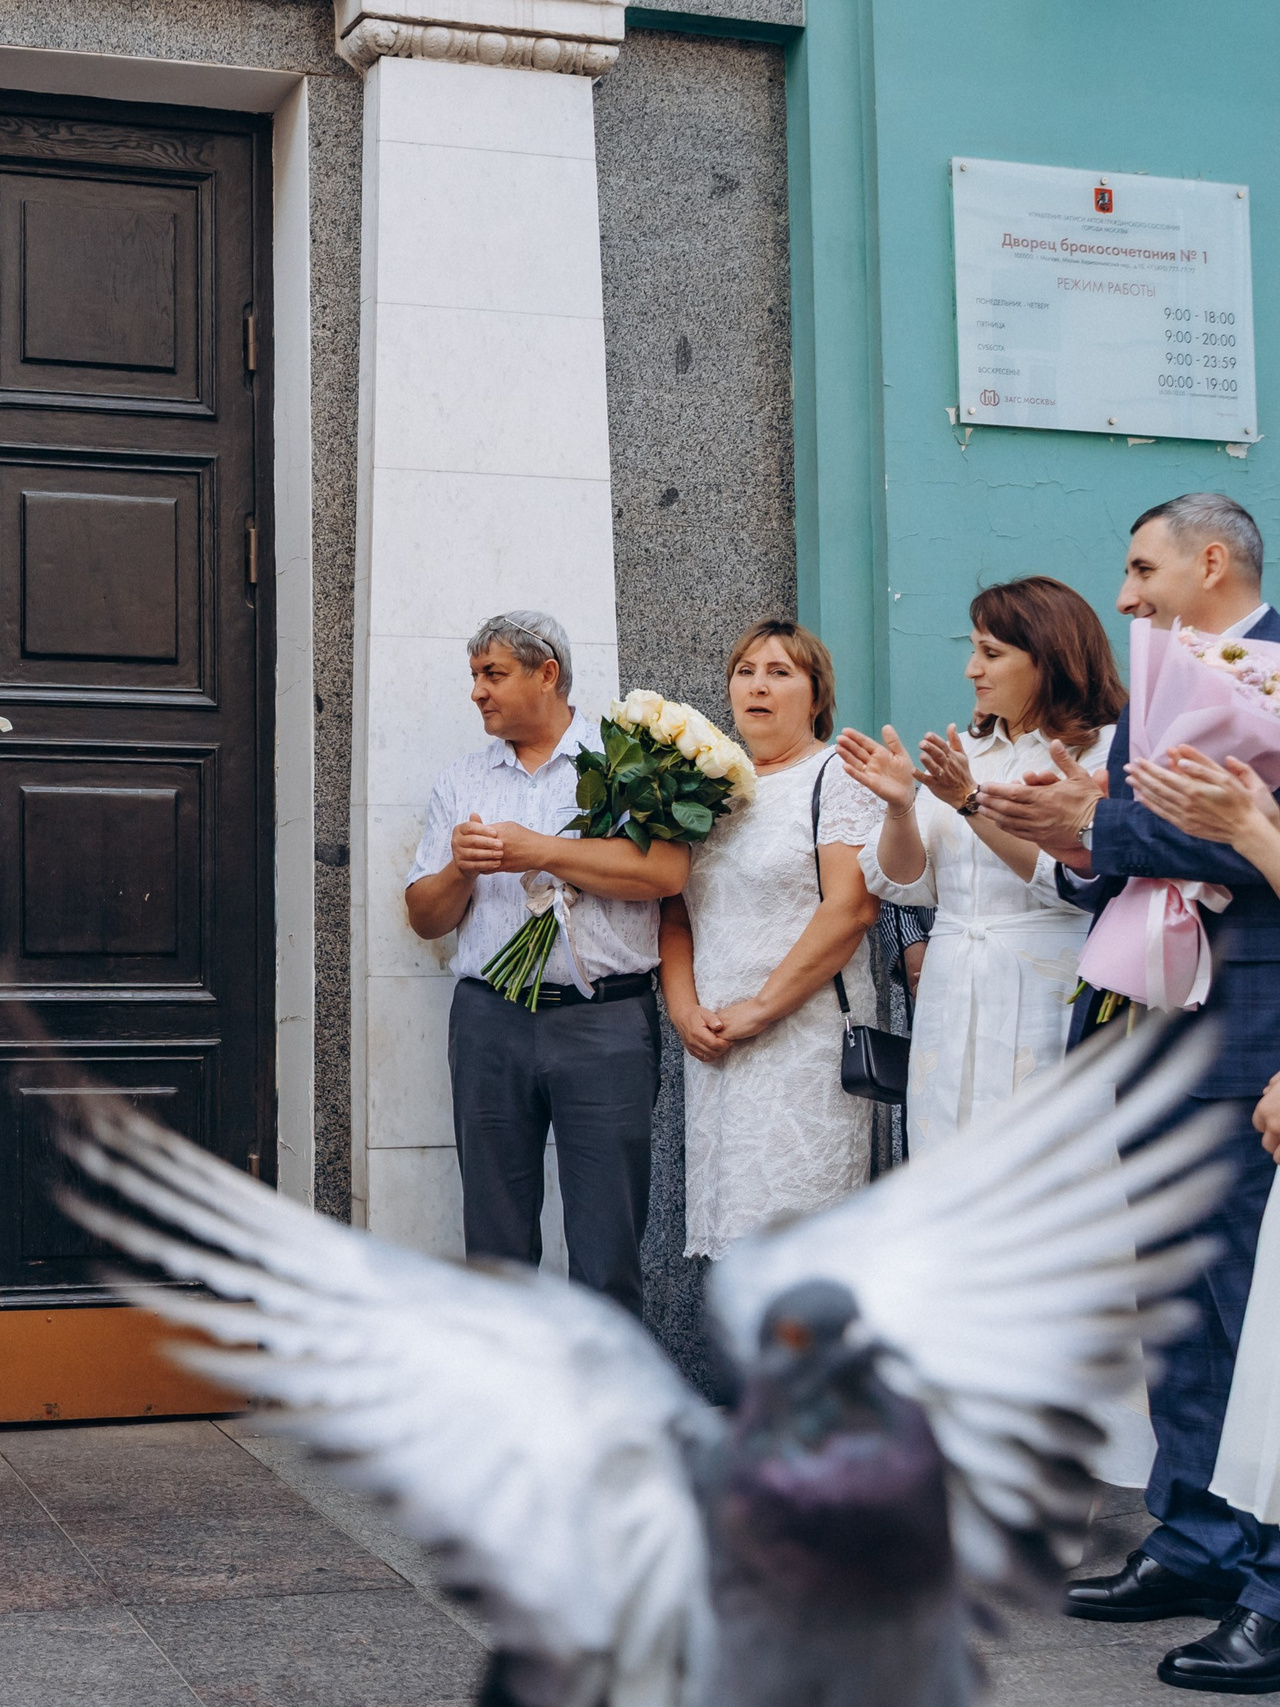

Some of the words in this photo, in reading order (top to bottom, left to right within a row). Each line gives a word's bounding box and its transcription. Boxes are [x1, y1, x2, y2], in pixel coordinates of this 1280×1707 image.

[1002, 233, 1056, 252] Дворец
[1060, 238, 1176, 261] бракосочетания
[1180, 248, 1196, 262] №
[1202, 251, 1207, 264] 1
[1057, 278, 1104, 292] РЕЖИМ
[1108, 282, 1156, 298] РАБОТЫ
[976, 298, 1022, 308] ПОНЕДЕЛЬНИК
[1027, 302, 1050, 310] ЧЕТВЕРГ
[1164, 307, 1191, 322] 9:00
[1204, 310, 1236, 325] 18:00
[976, 320, 1006, 330] ПЯТНИЦА
[1165, 330, 1192, 344] 9:00
[1202, 332, 1236, 348] 20:00
[977, 344, 1005, 352] СУББОТА
[1166, 352, 1192, 366] 9:00
[1203, 354, 1236, 369] 23:59
[978, 366, 1021, 376] ВОСКРЕСЕНЬЕ
[1158, 374, 1194, 389] 00:00
[1206, 378, 1238, 392] 19:00
[1004, 396, 1022, 404] ЗАГС
[1023, 397, 1056, 406] МОСКВЫ
